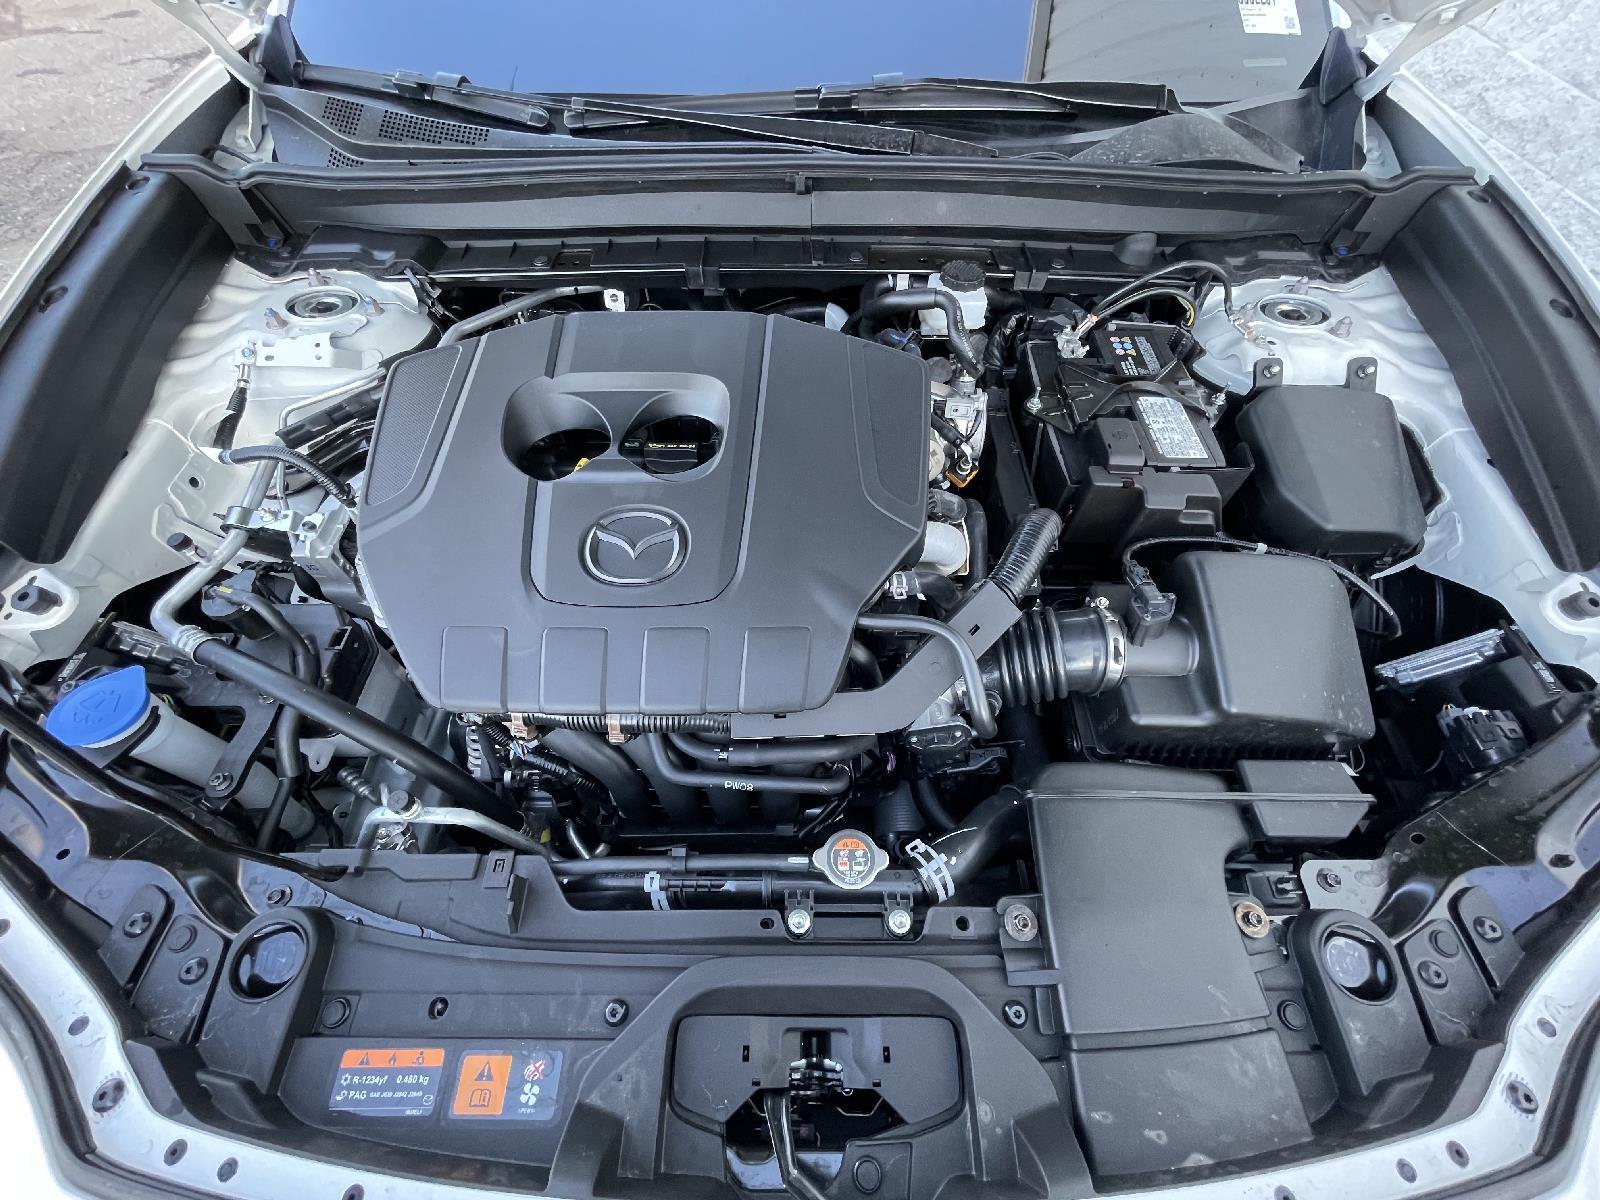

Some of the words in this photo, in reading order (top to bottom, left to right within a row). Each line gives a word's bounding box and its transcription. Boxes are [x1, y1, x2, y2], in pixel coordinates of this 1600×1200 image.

[352, 1075, 388, 1085] R-1234yf
[418, 1074, 429, 1085] kg
[348, 1090, 367, 1100] PAG
